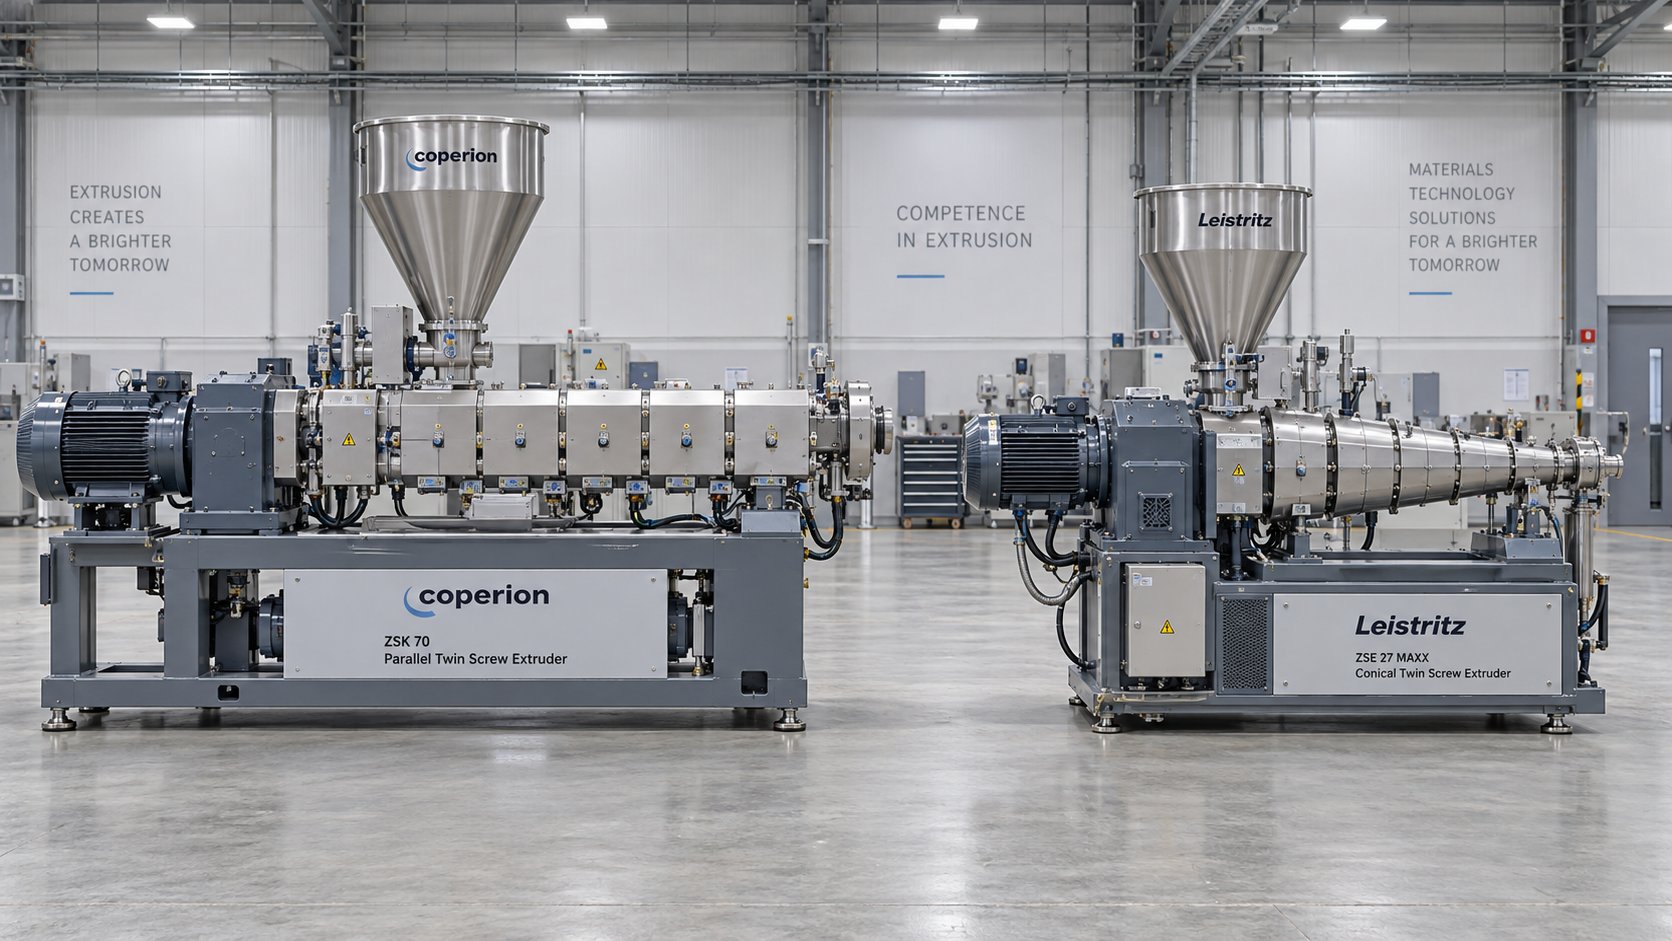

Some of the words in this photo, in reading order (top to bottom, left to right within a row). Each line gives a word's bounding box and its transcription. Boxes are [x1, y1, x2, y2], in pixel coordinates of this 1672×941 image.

[414, 148, 498, 166] coperion
[1409, 162, 1494, 177] MATERIALS
[70, 184, 162, 200] EXTRUSION
[1409, 186, 1515, 201] TECHNOLOGY
[69, 209, 145, 225] CREATES
[896, 204, 1026, 222] COMPETENCE
[1198, 212, 1273, 228] Leistritz
[1409, 210, 1496, 225] SOLUTIONS
[69, 233, 81, 249] A
[88, 233, 172, 249] BRIGHTER
[897, 231, 916, 249] IN
[926, 231, 1032, 249] EXTRUSION
[1409, 234, 1439, 249] FOR
[1445, 234, 1457, 249] A
[1462, 234, 1538, 249] BRIGHTER
[69, 257, 170, 273] TOMORROW
[1409, 257, 1500, 272] TOMORROW
[418, 584, 550, 609] coperion
[1355, 614, 1467, 636] Leistritz
[383, 635, 411, 648] ZSK
[413, 635, 430, 648] 70
[384, 652, 432, 665] Parallel
[434, 652, 465, 665] Twin
[468, 652, 509, 665] Screw
[512, 652, 568, 665] Extruder
[1355, 652, 1377, 663] ZSE
[1380, 652, 1394, 663] 27
[1396, 652, 1430, 663] MAXX
[1355, 667, 1397, 679] Conical
[1400, 667, 1425, 679] Twin
[1428, 667, 1462, 679] Screw
[1464, 667, 1512, 679] Extruder
